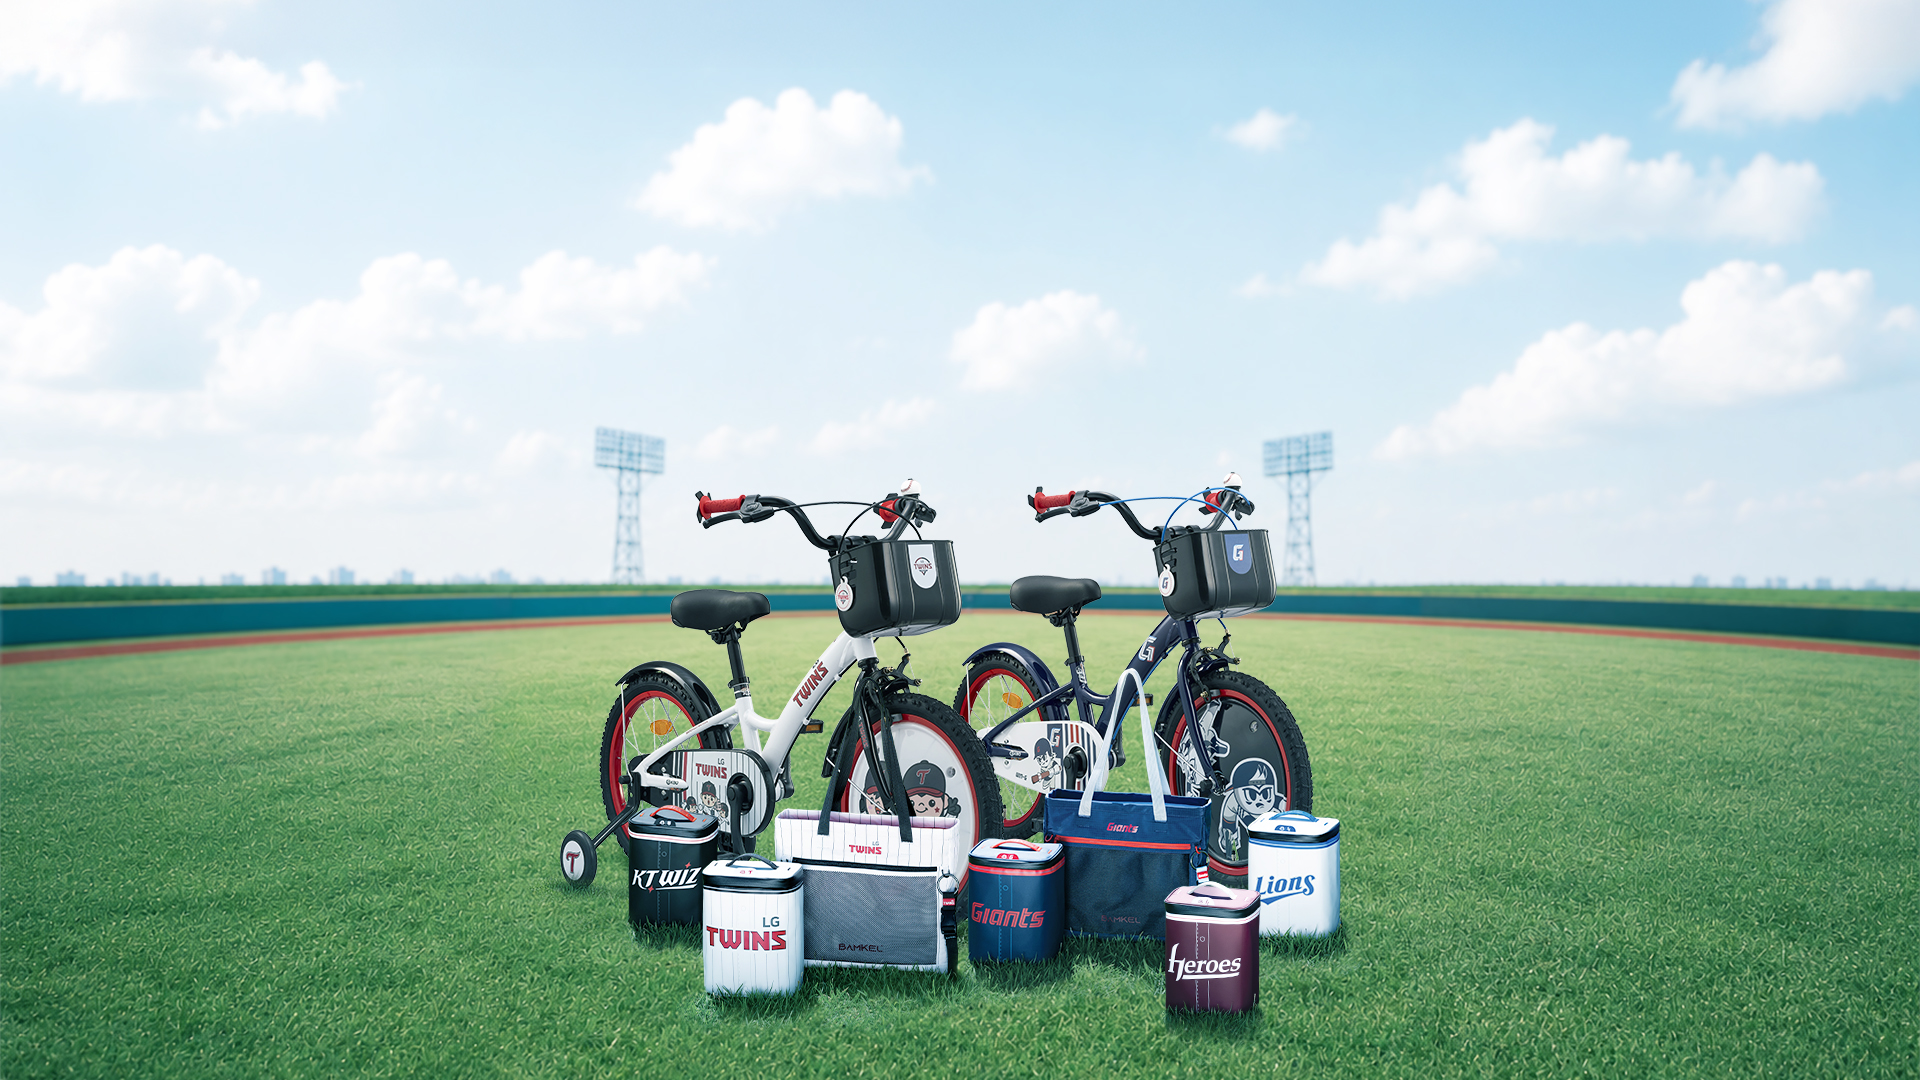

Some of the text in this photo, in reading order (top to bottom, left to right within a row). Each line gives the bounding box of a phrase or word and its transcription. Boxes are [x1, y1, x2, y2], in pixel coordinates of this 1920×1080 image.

[1232, 544, 1244, 561] G
[913, 562, 933, 570] TWINS
[1138, 635, 1157, 662] G
[792, 661, 829, 707] TWINS
[1050, 727, 1061, 747] G
[695, 763, 727, 779] TWINS
[917, 768, 931, 784] T
[849, 844, 882, 855] TWINS
[565, 851, 580, 873] T
[762, 916, 780, 928] LG
[706, 925, 786, 951] TWINS
[838, 943, 883, 952] BAMKEL
